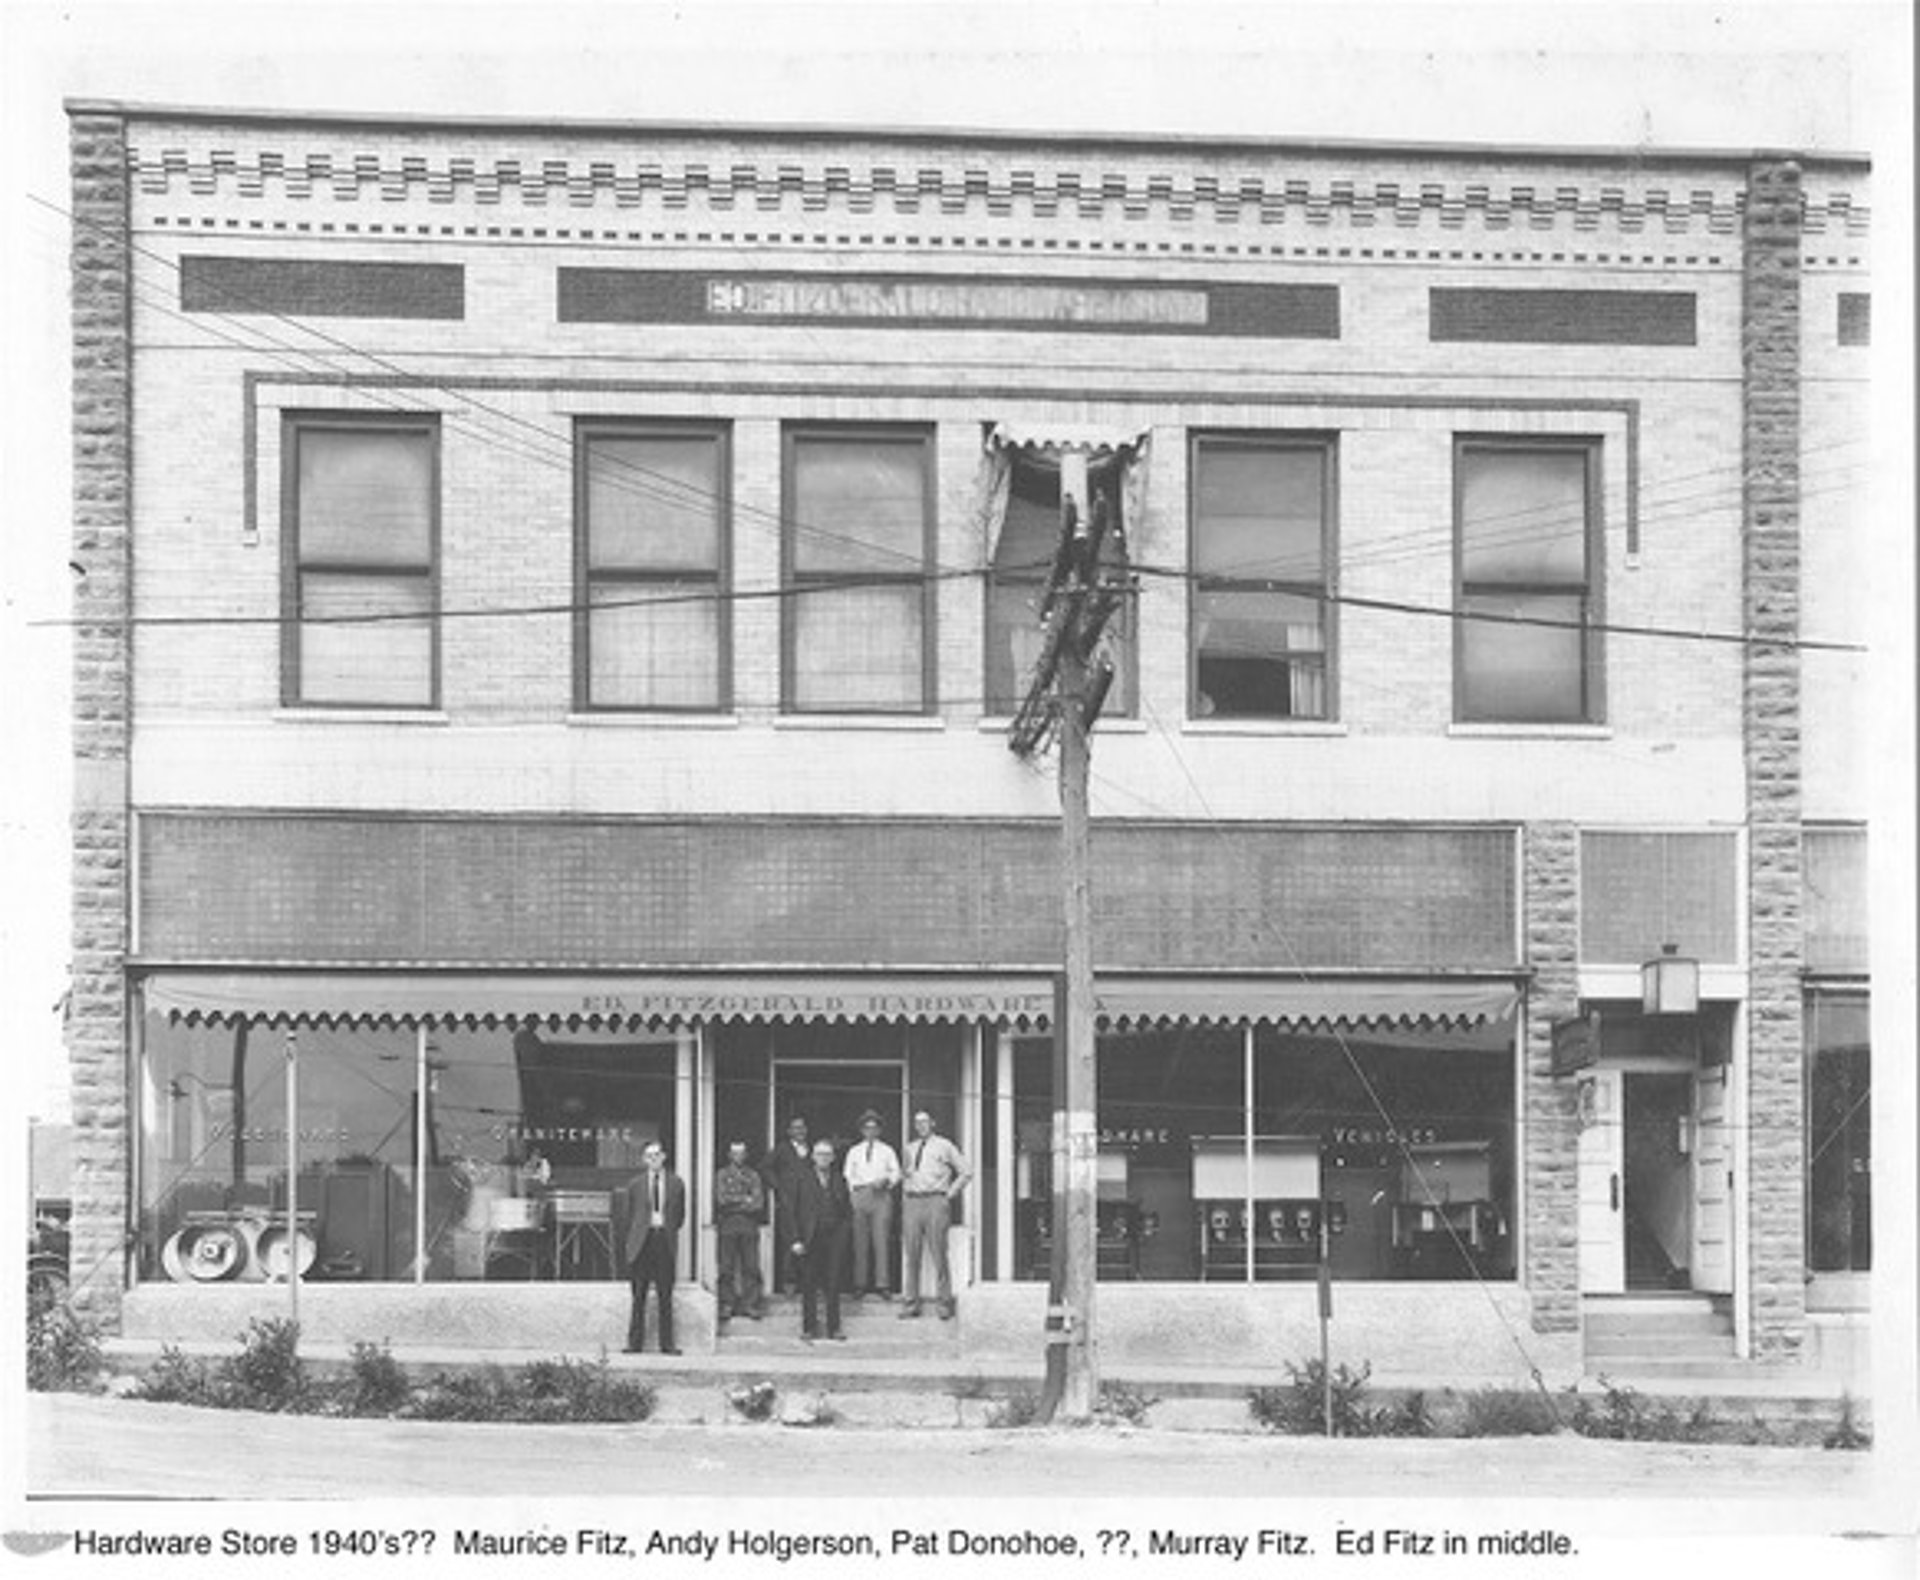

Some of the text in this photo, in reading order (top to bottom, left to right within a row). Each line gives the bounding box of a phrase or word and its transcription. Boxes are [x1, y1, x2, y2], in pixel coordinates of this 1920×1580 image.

[642, 995, 845, 1012] FITZGERALD
[868, 996, 1043, 1012] HARDWARE
[1333, 1127, 1435, 1144] VEHICLES
